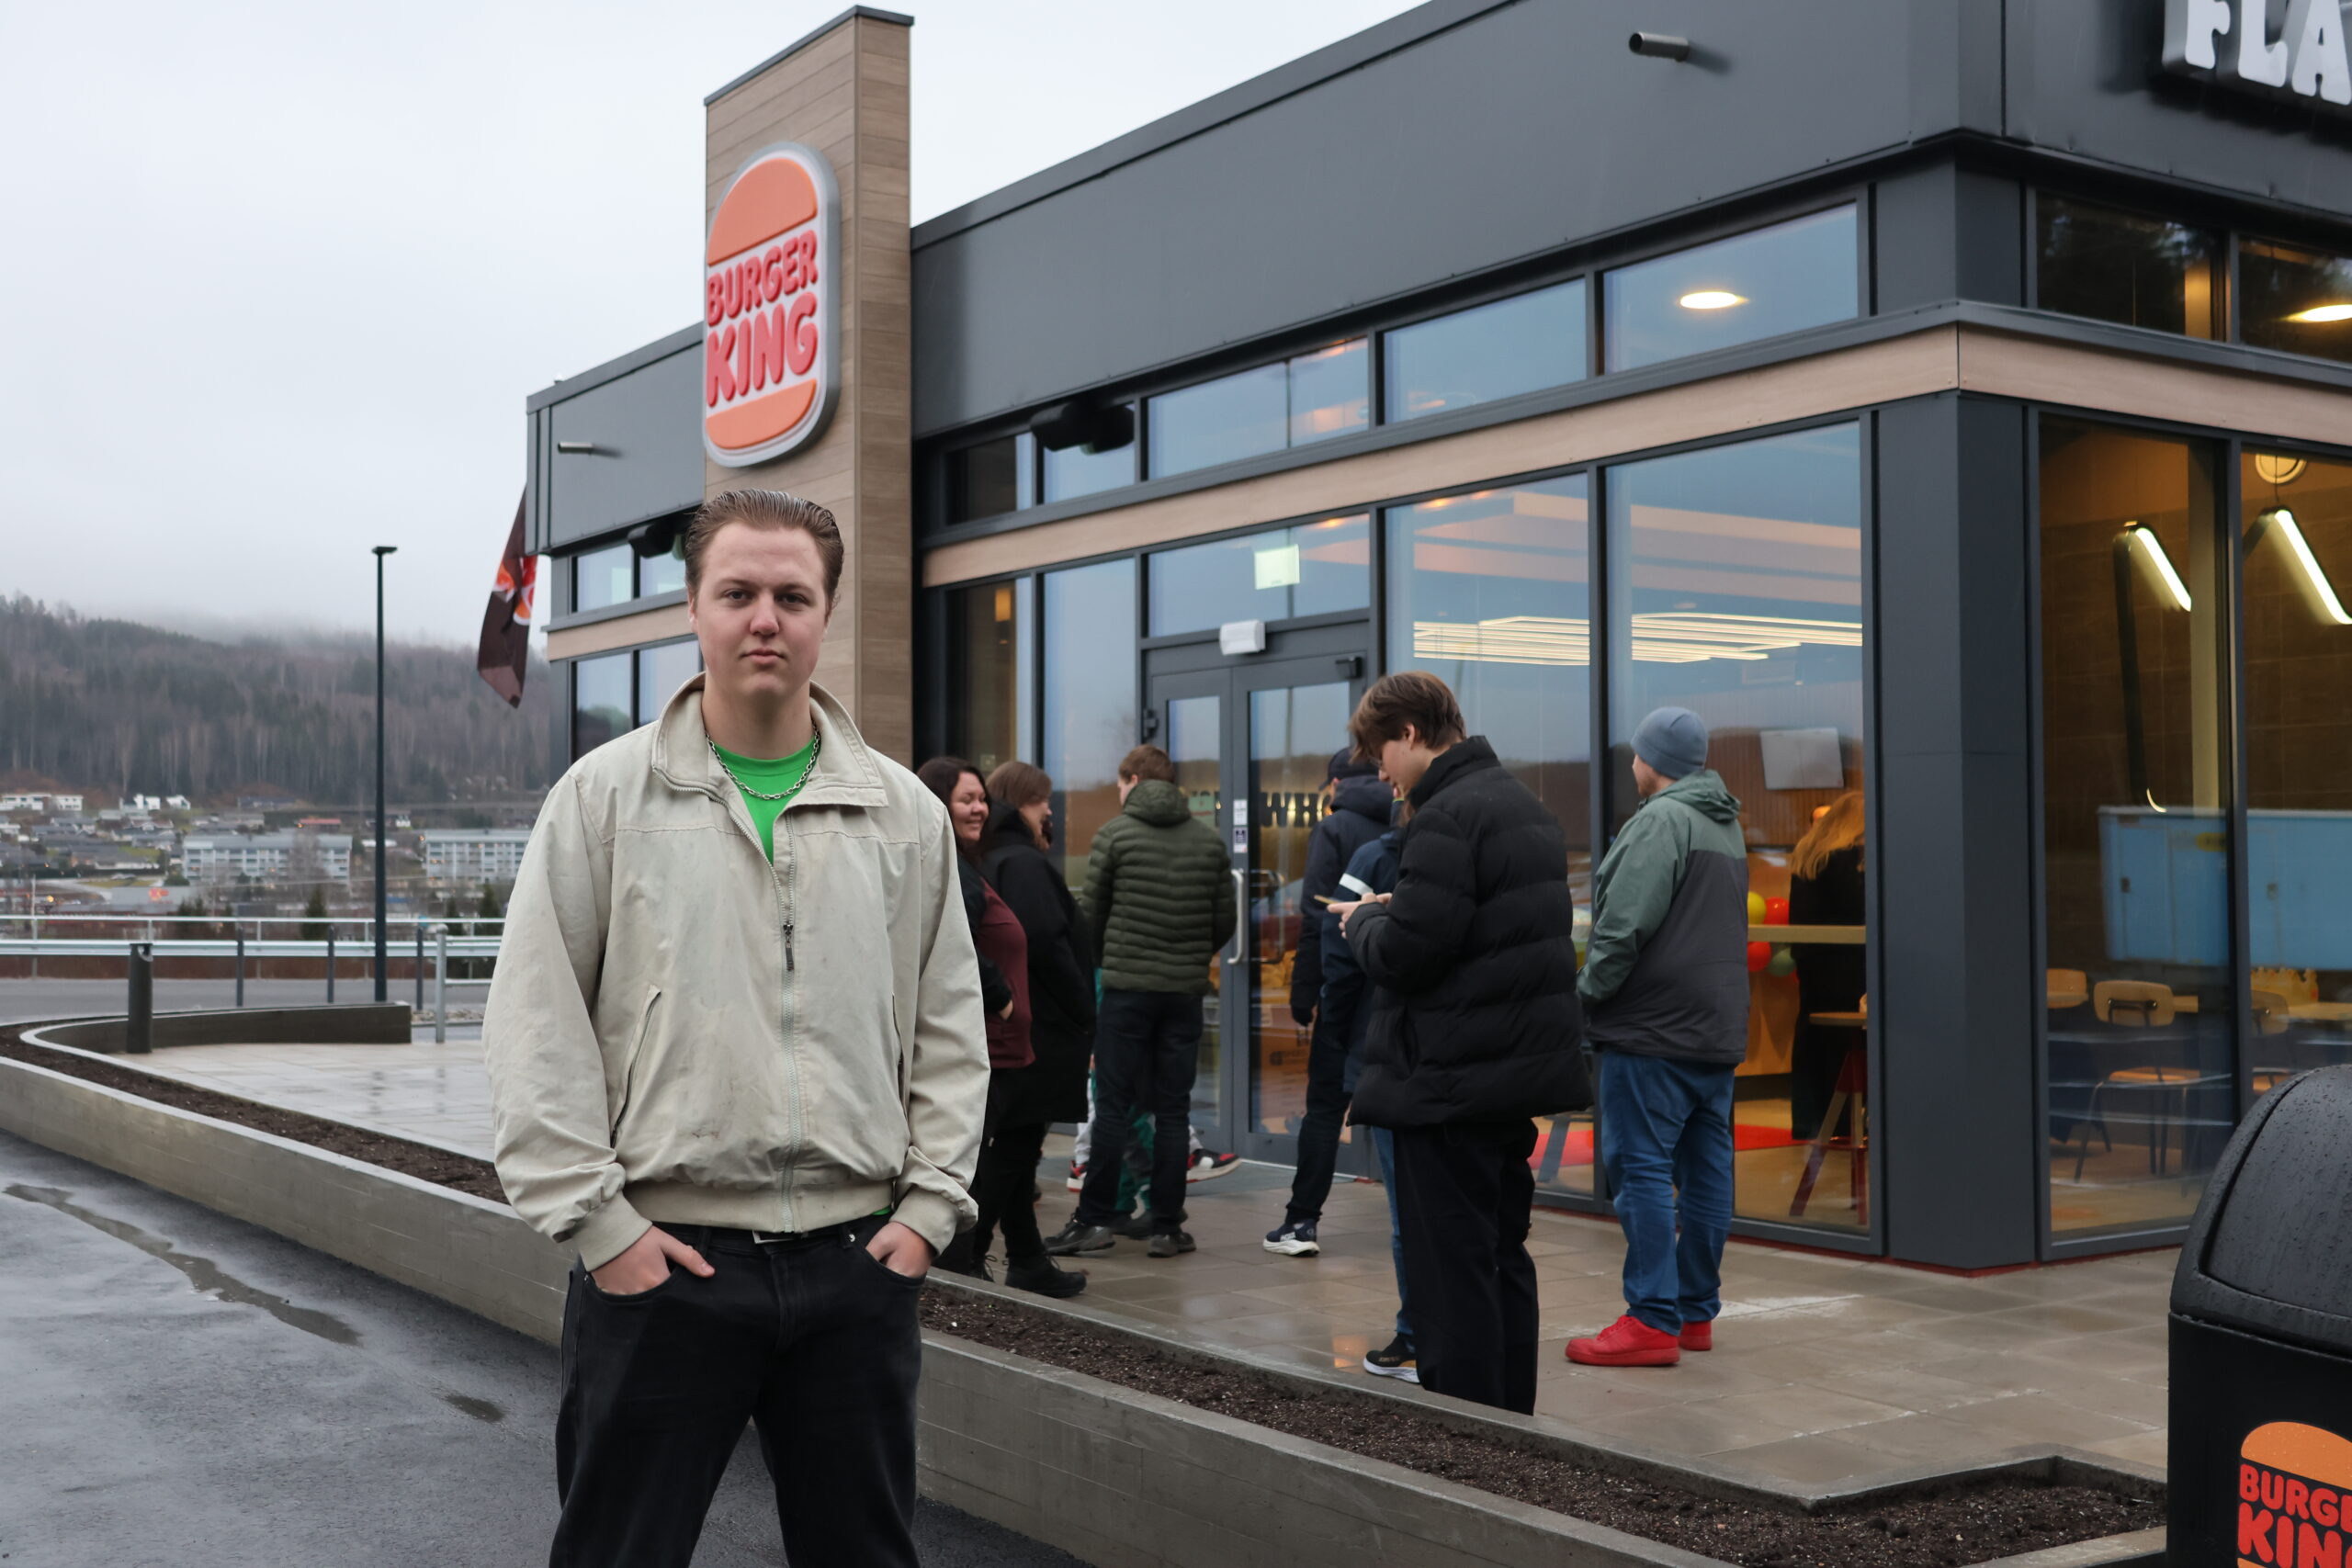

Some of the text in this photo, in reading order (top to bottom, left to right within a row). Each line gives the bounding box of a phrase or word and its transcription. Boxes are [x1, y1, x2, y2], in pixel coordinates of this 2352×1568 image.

[707, 229, 819, 327] BURGER
[706, 290, 819, 408] KING
[2237, 1502, 2352, 1568] KIN
